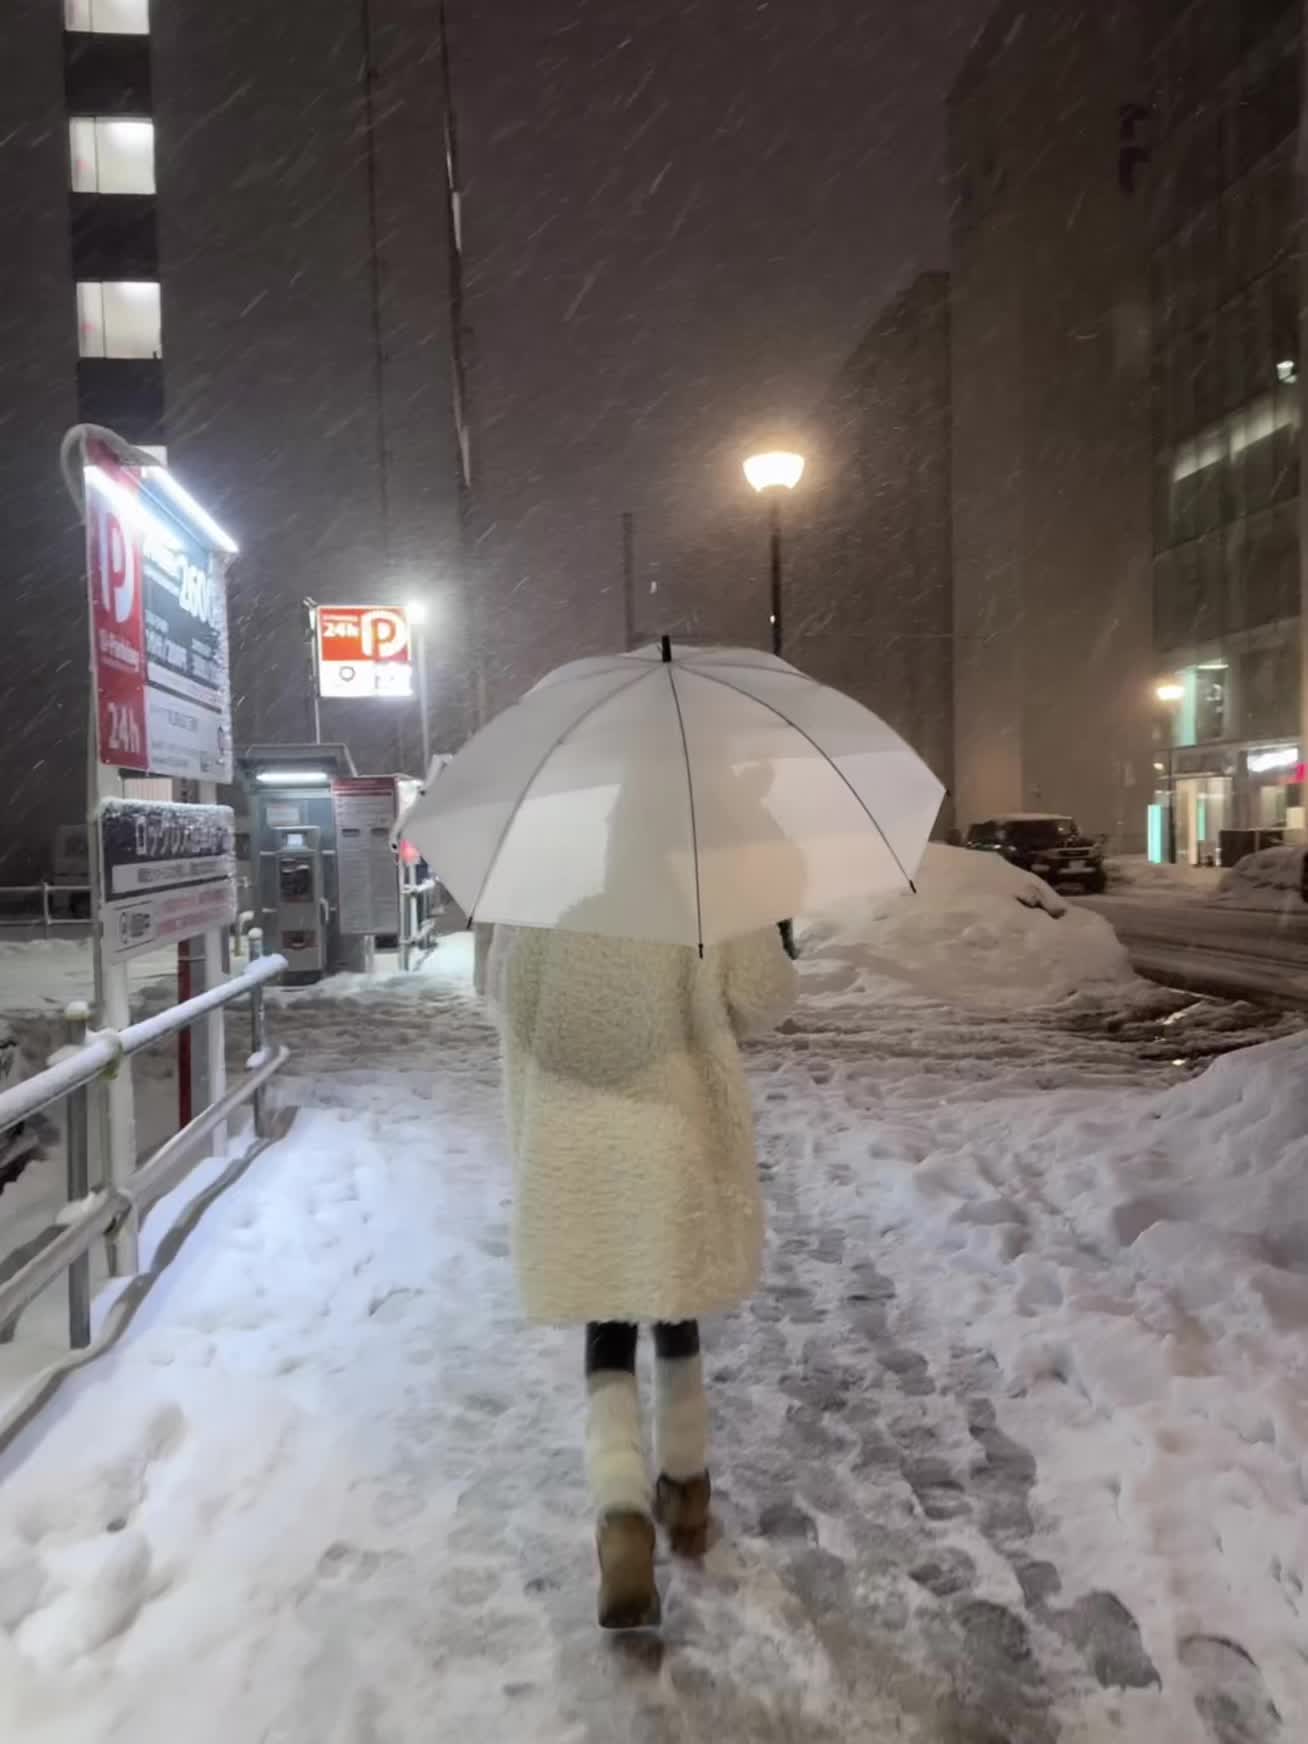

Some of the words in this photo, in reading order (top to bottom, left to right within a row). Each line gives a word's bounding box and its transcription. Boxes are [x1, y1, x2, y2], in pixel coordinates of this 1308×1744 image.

[323, 621, 359, 638] 24h
[361, 610, 407, 658] P
[108, 702, 141, 753] 24h
